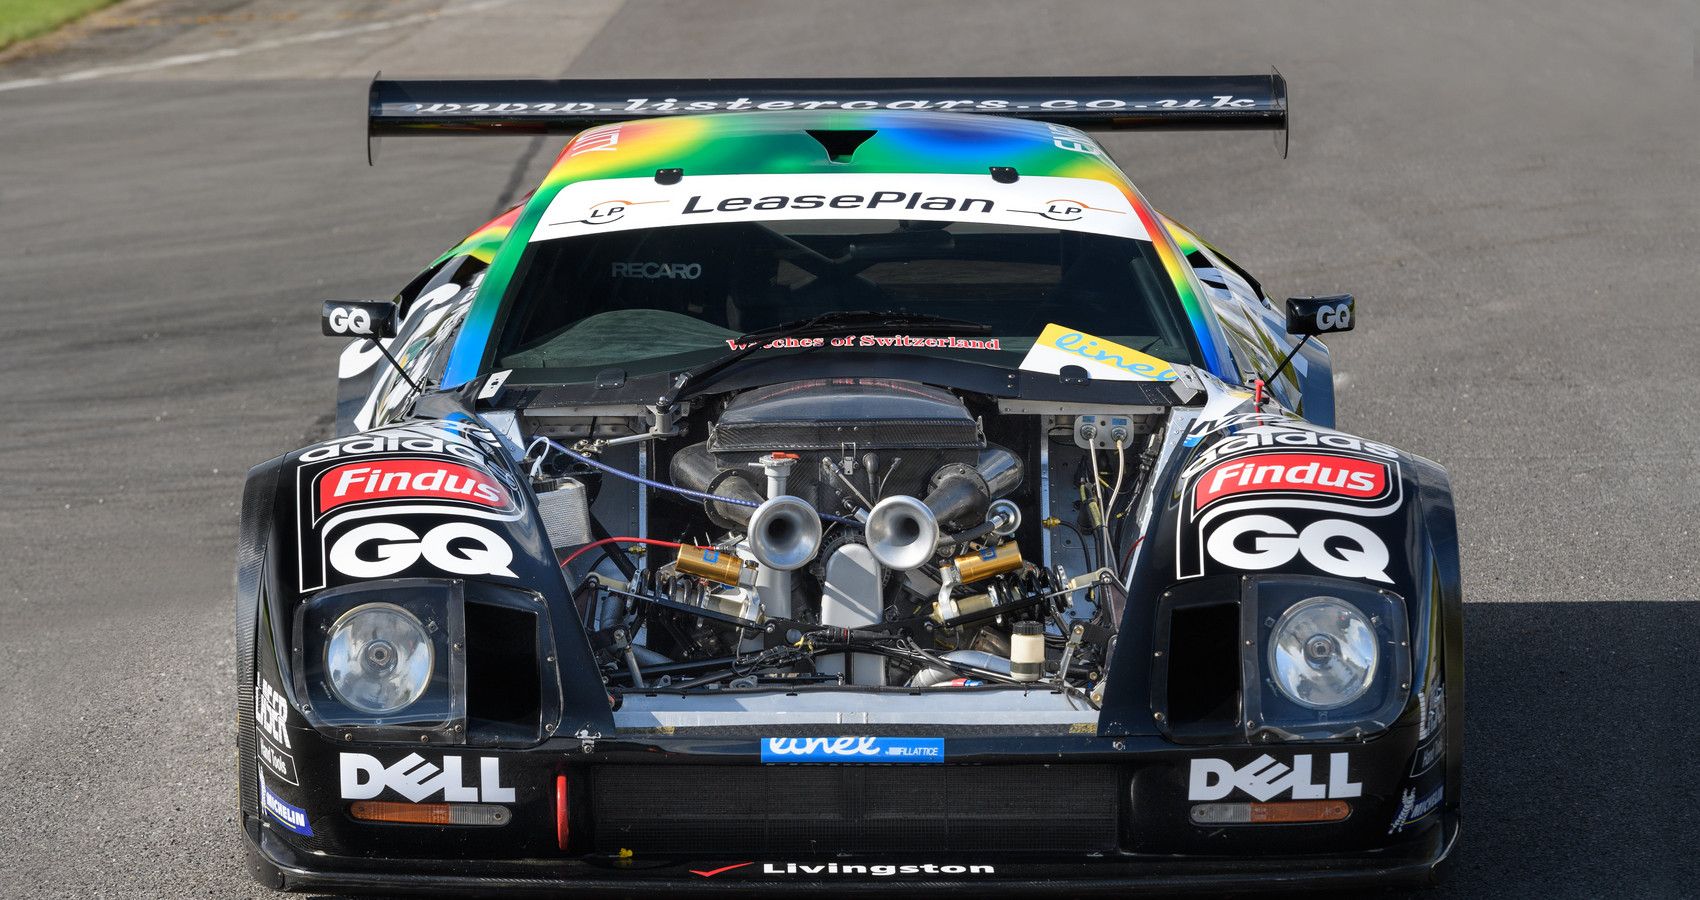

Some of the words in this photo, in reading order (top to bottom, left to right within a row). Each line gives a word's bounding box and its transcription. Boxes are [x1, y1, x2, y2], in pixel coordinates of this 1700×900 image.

[403, 96, 1256, 112] www.listercars.co.uk
[591, 205, 625, 219] LP
[682, 191, 994, 215] LeasePlan
[1047, 203, 1083, 216] LP
[611, 262, 702, 280] RECARO
[329, 307, 374, 335] GQ
[1316, 304, 1351, 331] GQ
[726, 337, 824, 351] Wches
[831, 335, 856, 347] of
[860, 335, 1001, 350] Switzerland
[1182, 431, 1399, 479] adidas
[333, 467, 500, 502] Findus
[1208, 462, 1376, 494] Findus
[330, 522, 519, 578] GQ
[1207, 514, 1395, 584] GQ
[340, 752, 515, 803] DELL
[1188, 752, 1362, 803] DELL
[763, 863, 995, 876] Livingston
